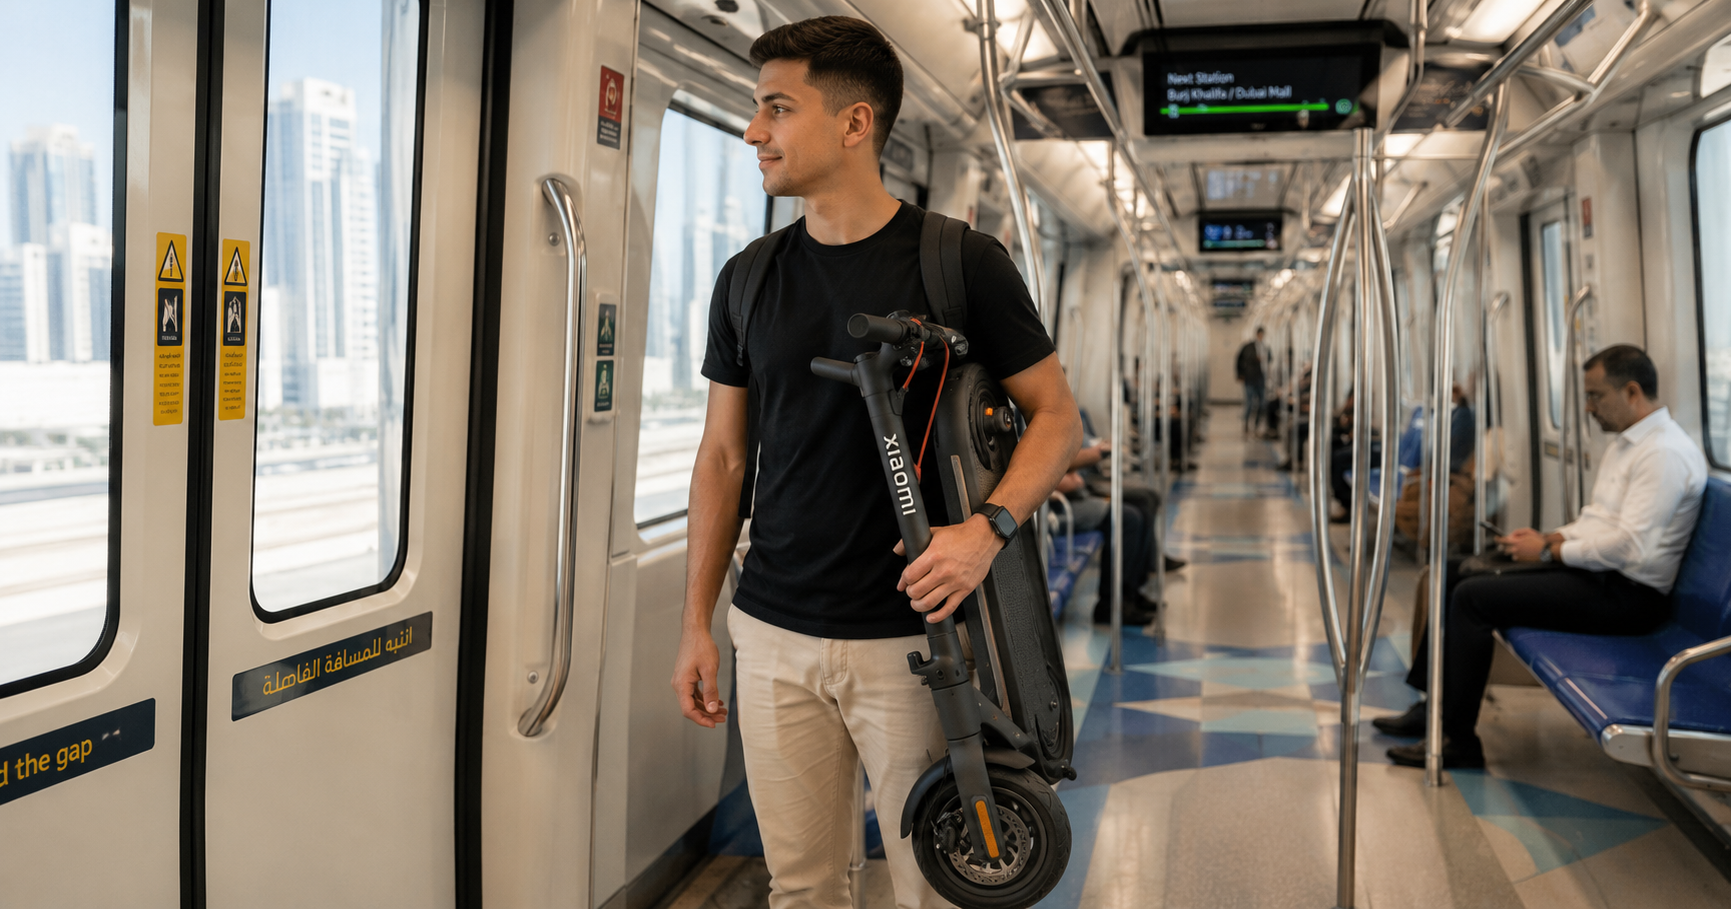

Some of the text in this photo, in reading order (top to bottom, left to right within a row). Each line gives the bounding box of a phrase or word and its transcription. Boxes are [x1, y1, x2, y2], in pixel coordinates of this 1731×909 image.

[1167, 71, 1234, 85] Next Station
[1167, 88, 1190, 102] Burj
[1191, 88, 1227, 100] Khalifa
[1235, 86, 1267, 99] Dubai
[1268, 85, 1292, 98] Mall
[883, 433, 917, 516] xiaomi
[324, 637, 381, 673] للمسافة
[14, 753, 51, 780] the
[56, 739, 93, 771] gap
